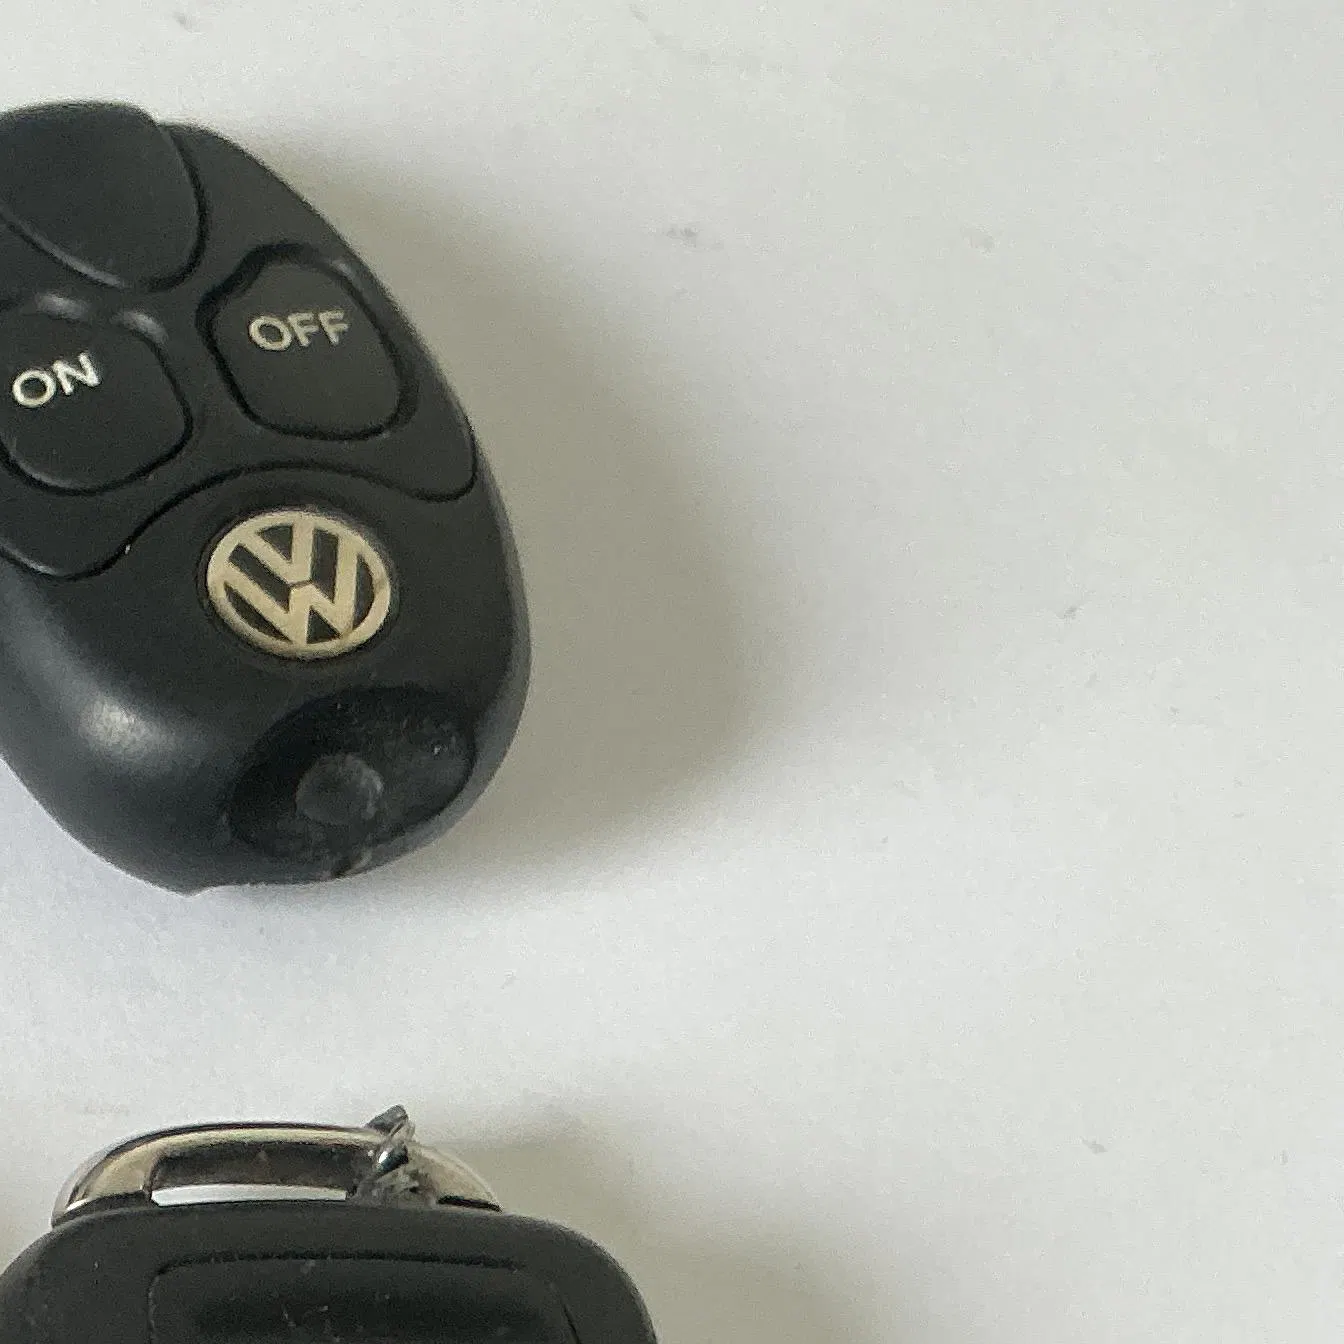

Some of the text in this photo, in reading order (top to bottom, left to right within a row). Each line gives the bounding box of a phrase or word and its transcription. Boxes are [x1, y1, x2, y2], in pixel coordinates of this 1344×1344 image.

[248, 309, 351, 352] OFF
[11, 351, 102, 409] ON
[208, 509, 390, 657] VW
